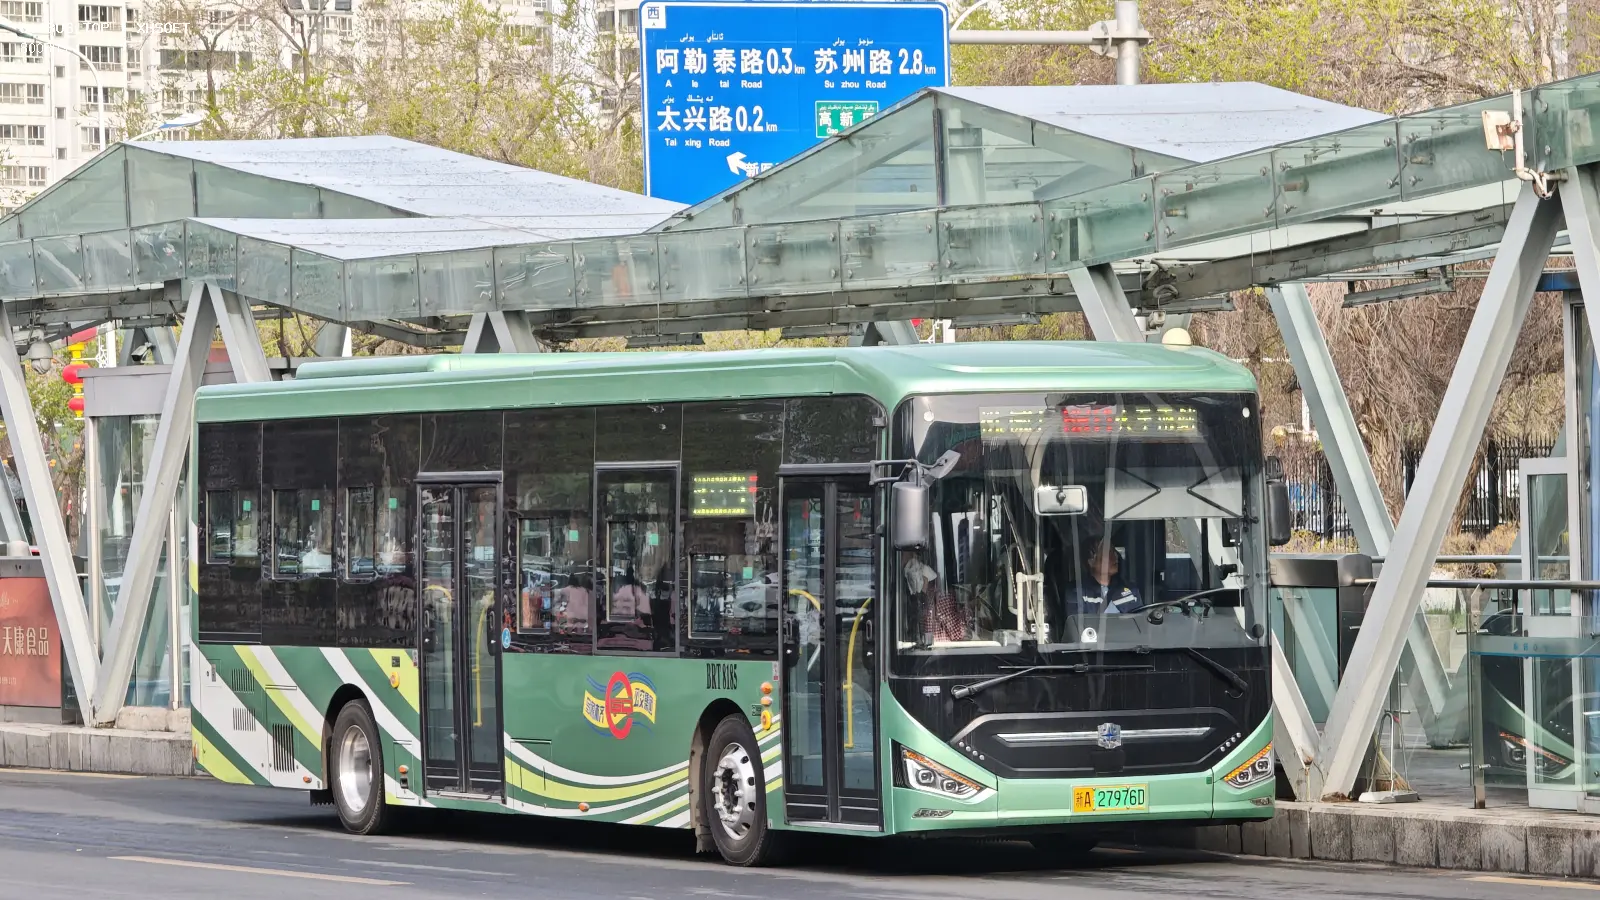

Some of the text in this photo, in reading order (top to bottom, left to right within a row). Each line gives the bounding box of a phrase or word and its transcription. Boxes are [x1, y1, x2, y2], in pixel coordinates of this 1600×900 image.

[646, 6, 660, 20] 西
[656, 47, 764, 75] 阿勒泰路
[813, 47, 893, 75] 苏州路
[665, 79, 763, 89] A le tai Road
[824, 80, 887, 89] Su zhou Road
[656, 105, 734, 132] 太兴路
[664, 137, 731, 149] Tai xing Road
[2, 626, 49, 656] 天康食品
[706, 663, 738, 690] BRT 8185
[1098, 789, 1145, 807] 27976D
